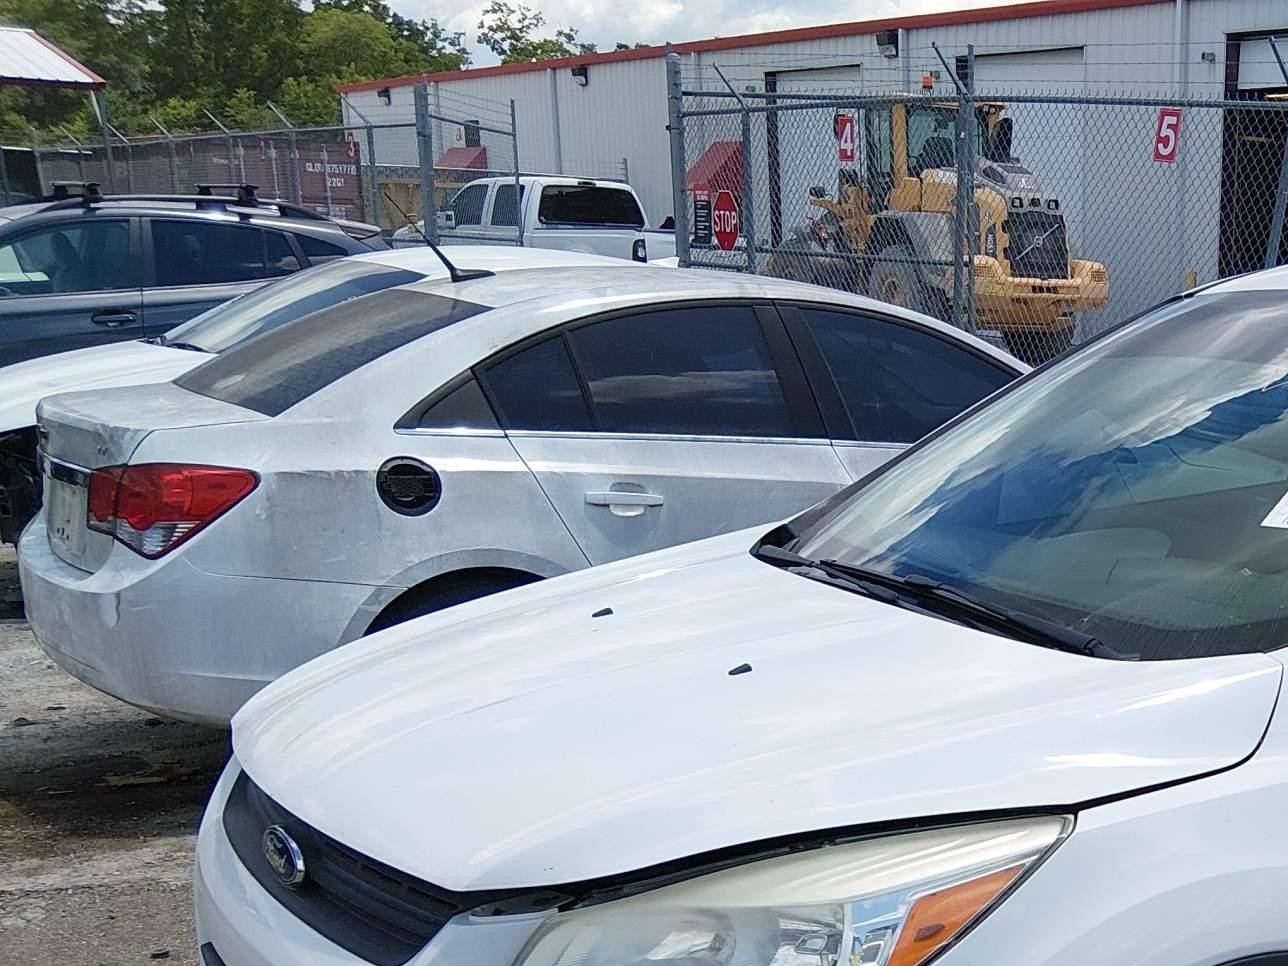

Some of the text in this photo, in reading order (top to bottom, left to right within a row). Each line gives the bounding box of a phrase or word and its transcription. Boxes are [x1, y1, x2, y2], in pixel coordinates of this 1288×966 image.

[840, 121, 854, 157] 4
[1157, 115, 1178, 156] 5
[714, 210, 737, 233] STOP
